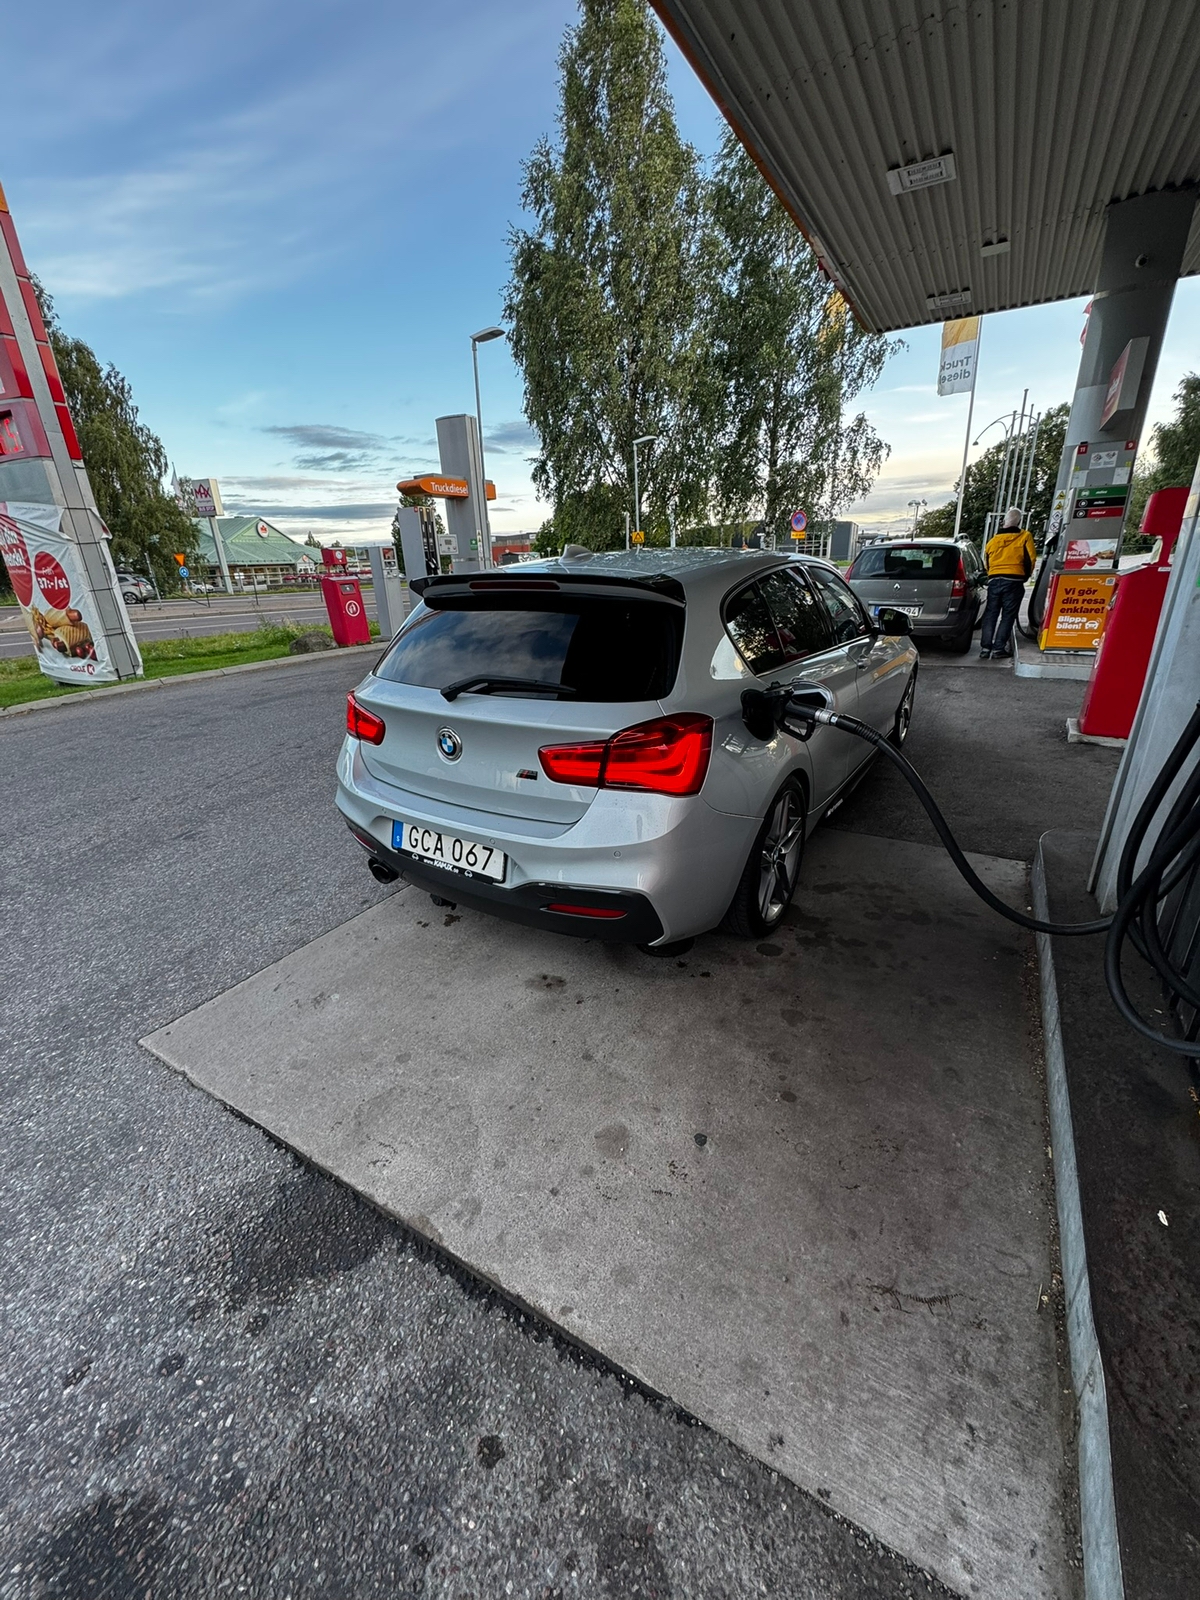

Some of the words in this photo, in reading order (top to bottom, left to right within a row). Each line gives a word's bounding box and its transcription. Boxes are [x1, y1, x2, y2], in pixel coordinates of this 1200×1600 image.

[194, 483, 212, 499] MAX
[430, 481, 469, 495] Truckdiesel
[37, 576, 69, 590] 37:-/st
[1064, 588, 1076, 596] Vi
[1077, 588, 1098, 597] gör
[1061, 597, 1079, 605] din
[1060, 606, 1105, 614] enklare!
[1057, 615, 1087, 623] Blippa
[409, 825, 444, 858] GCA
[451, 838, 494, 871] 067
